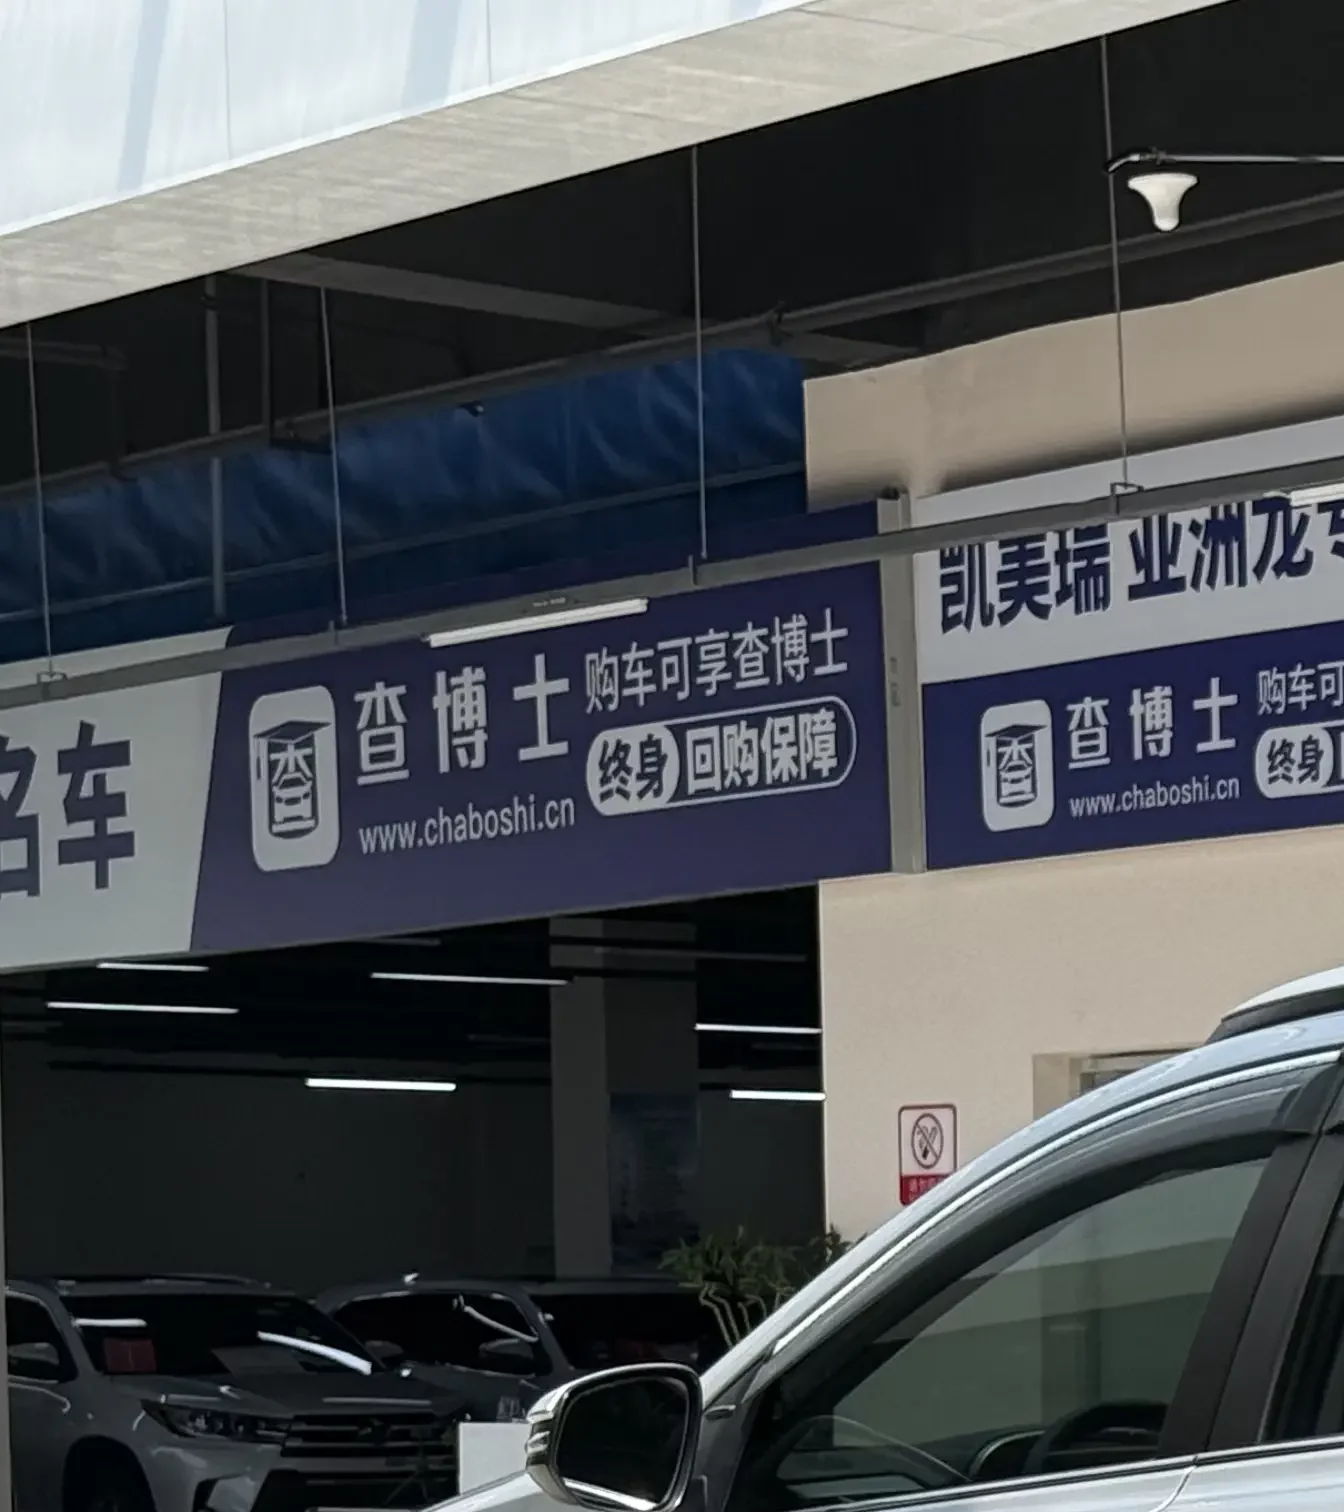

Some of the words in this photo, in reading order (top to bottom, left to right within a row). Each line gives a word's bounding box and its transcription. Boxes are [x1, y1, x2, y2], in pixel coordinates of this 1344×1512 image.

[939, 522, 1113, 635] 凯美瑞
[585, 607, 849, 714] 购车可享查博士
[353, 653, 570, 786] 查博士
[598, 732, 669, 804] 终身
[685, 706, 839, 796] 回购保障
[1065, 676, 1239, 770] 查博士
[359, 793, 576, 855] www.chaboshi.cn
[1069, 774, 1240, 818] www.chaboshi.cn
